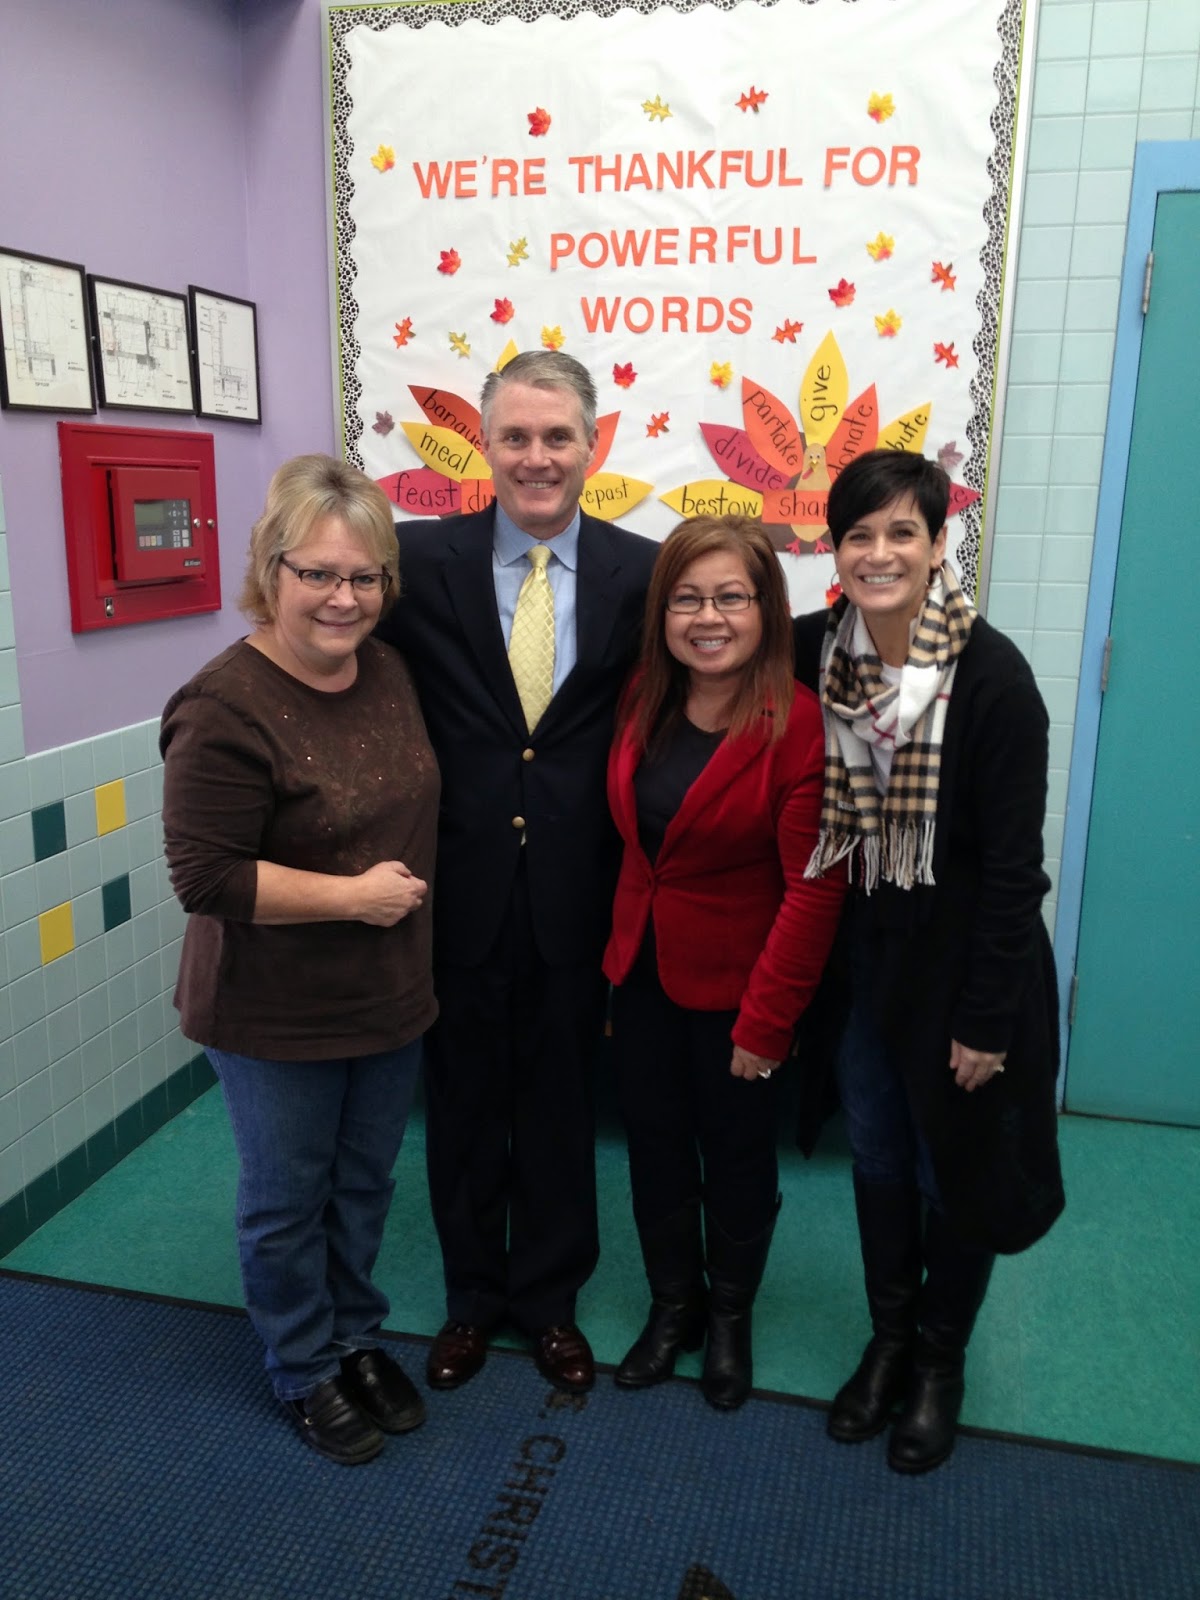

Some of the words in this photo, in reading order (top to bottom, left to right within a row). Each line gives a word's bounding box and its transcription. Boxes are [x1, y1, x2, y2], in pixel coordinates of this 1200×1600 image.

[414, 156, 546, 198] WE'RE
[569, 149, 802, 192] THANKFUL
[825, 146, 920, 186] FOR
[551, 226, 817, 270] POWERFUL
[582, 297, 753, 334] WORDS
[804, 364, 838, 422] give
[423, 389, 482, 451] banque
[743, 390, 798, 466] partake
[885, 413, 927, 451] bute
[420, 432, 474, 474] meal
[715, 431, 784, 491] divide
[393, 472, 458, 508] feast
[581, 478, 628, 510] epast
[682, 486, 758, 515] bestow
[779, 491, 827, 517] shar
[447, 1434, 567, 1600] CHRIST
